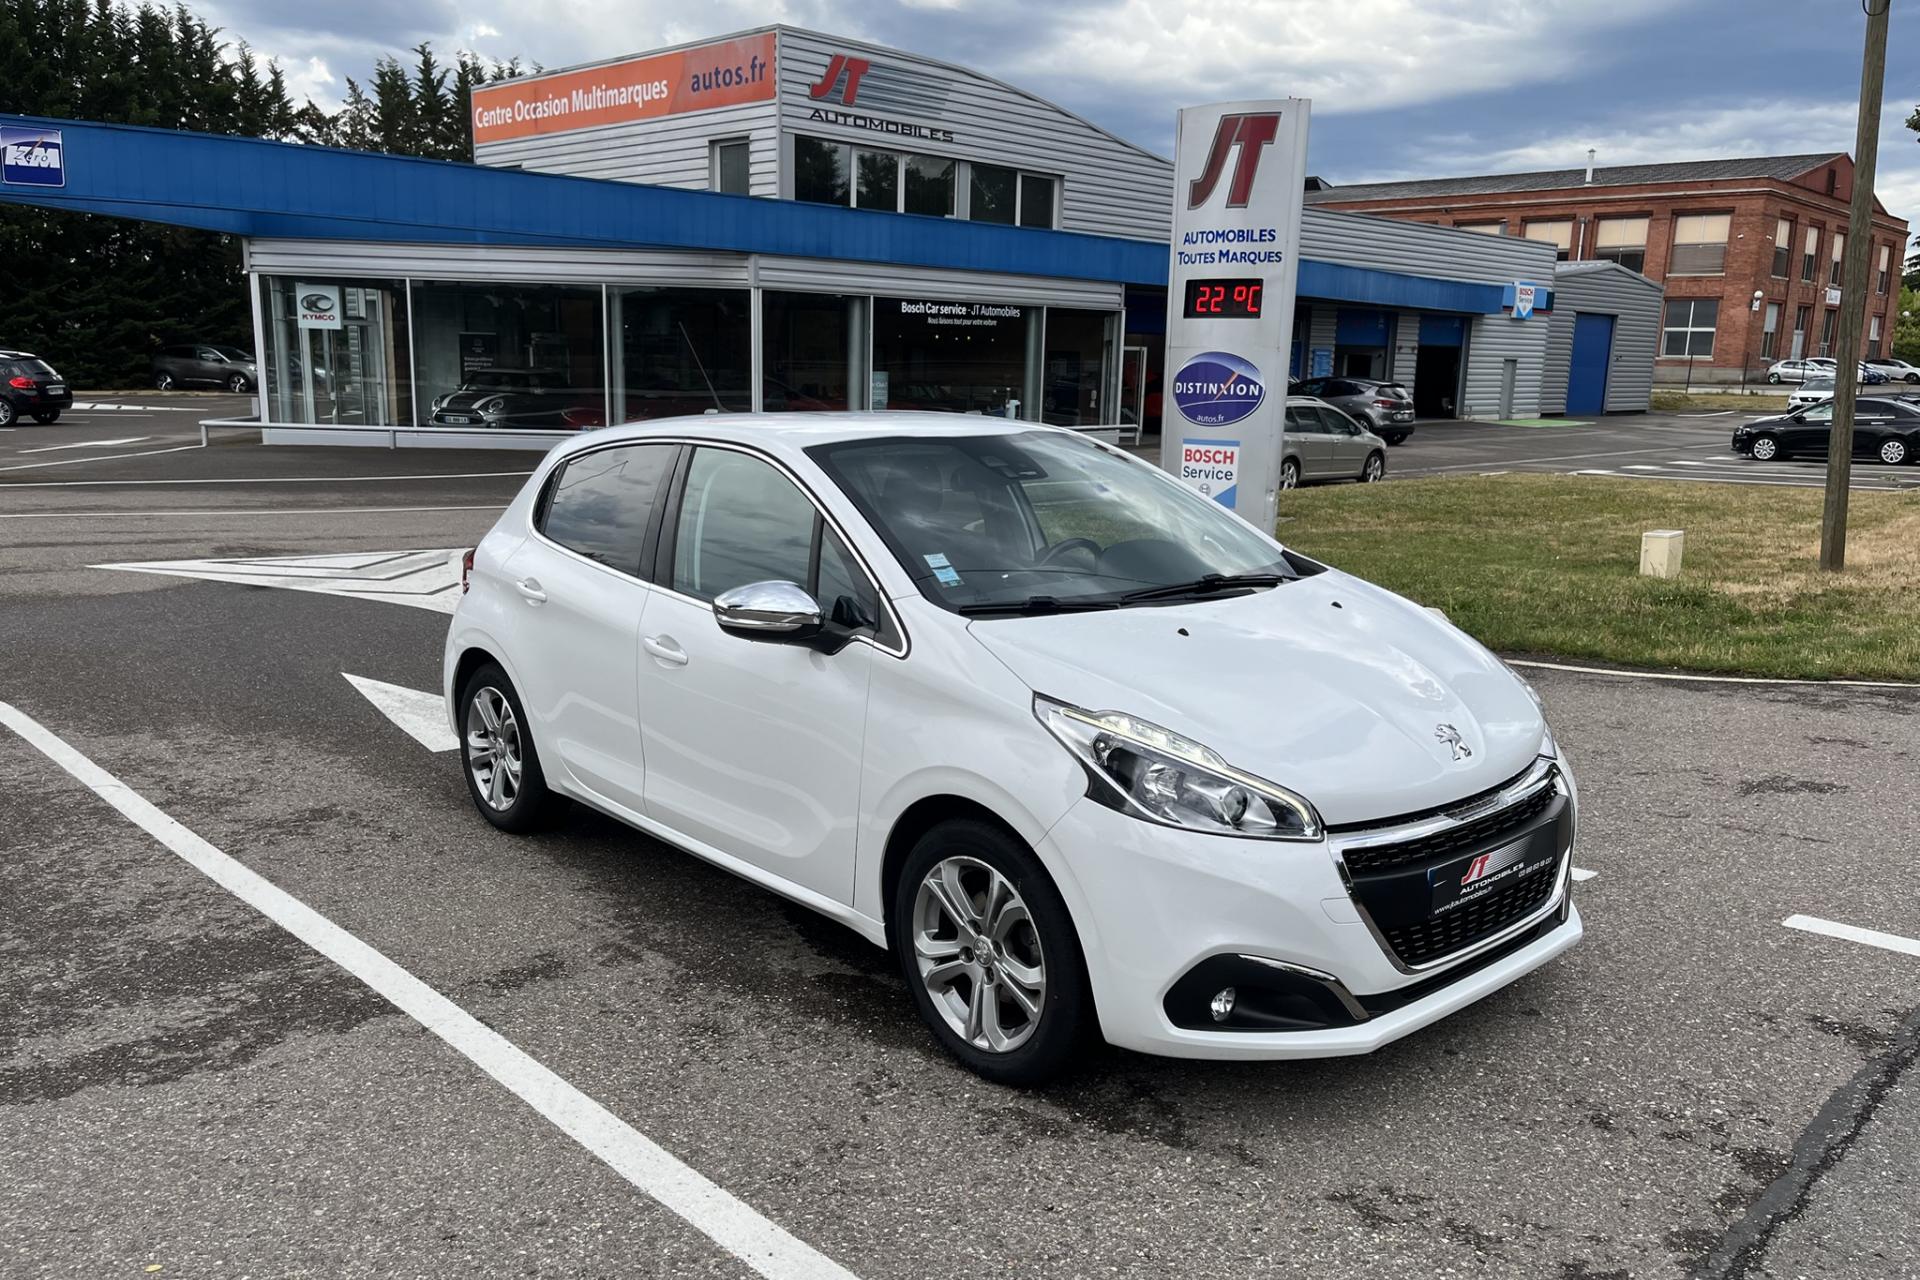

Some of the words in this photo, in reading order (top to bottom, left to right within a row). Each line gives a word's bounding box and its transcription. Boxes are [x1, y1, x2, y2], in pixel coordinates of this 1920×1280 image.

[691, 56, 766, 92] autos.fr
[809, 53, 871, 107] JT
[475, 107, 513, 128] Centre
[514, 94, 569, 122] Occasion
[571, 79, 668, 113] Multimarques
[810, 109, 954, 142] AUTOMOBILES
[5, 145, 60, 169] KM
[1187, 111, 1282, 211] JT
[1184, 229, 1276, 245] AUTOMOBILES
[901, 302, 925, 314] Bosch
[925, 303, 939, 314] Car
[940, 304, 967, 315] service
[971, 305, 980, 316] JT
[980, 306, 1021, 318] Automobiles
[1196, 286, 1225, 312] 22
[302, 313, 336, 321] KYMCO
[1175, 382, 1260, 396] DISTINXION
[1197, 414, 1224, 423] autos.fr
[1184, 448, 1235, 464] BOSCH
[1183, 465, 1234, 481] Service
[1460, 862, 1525, 895] AUTOMOBILES
[1461, 853, 1491, 885] JT
